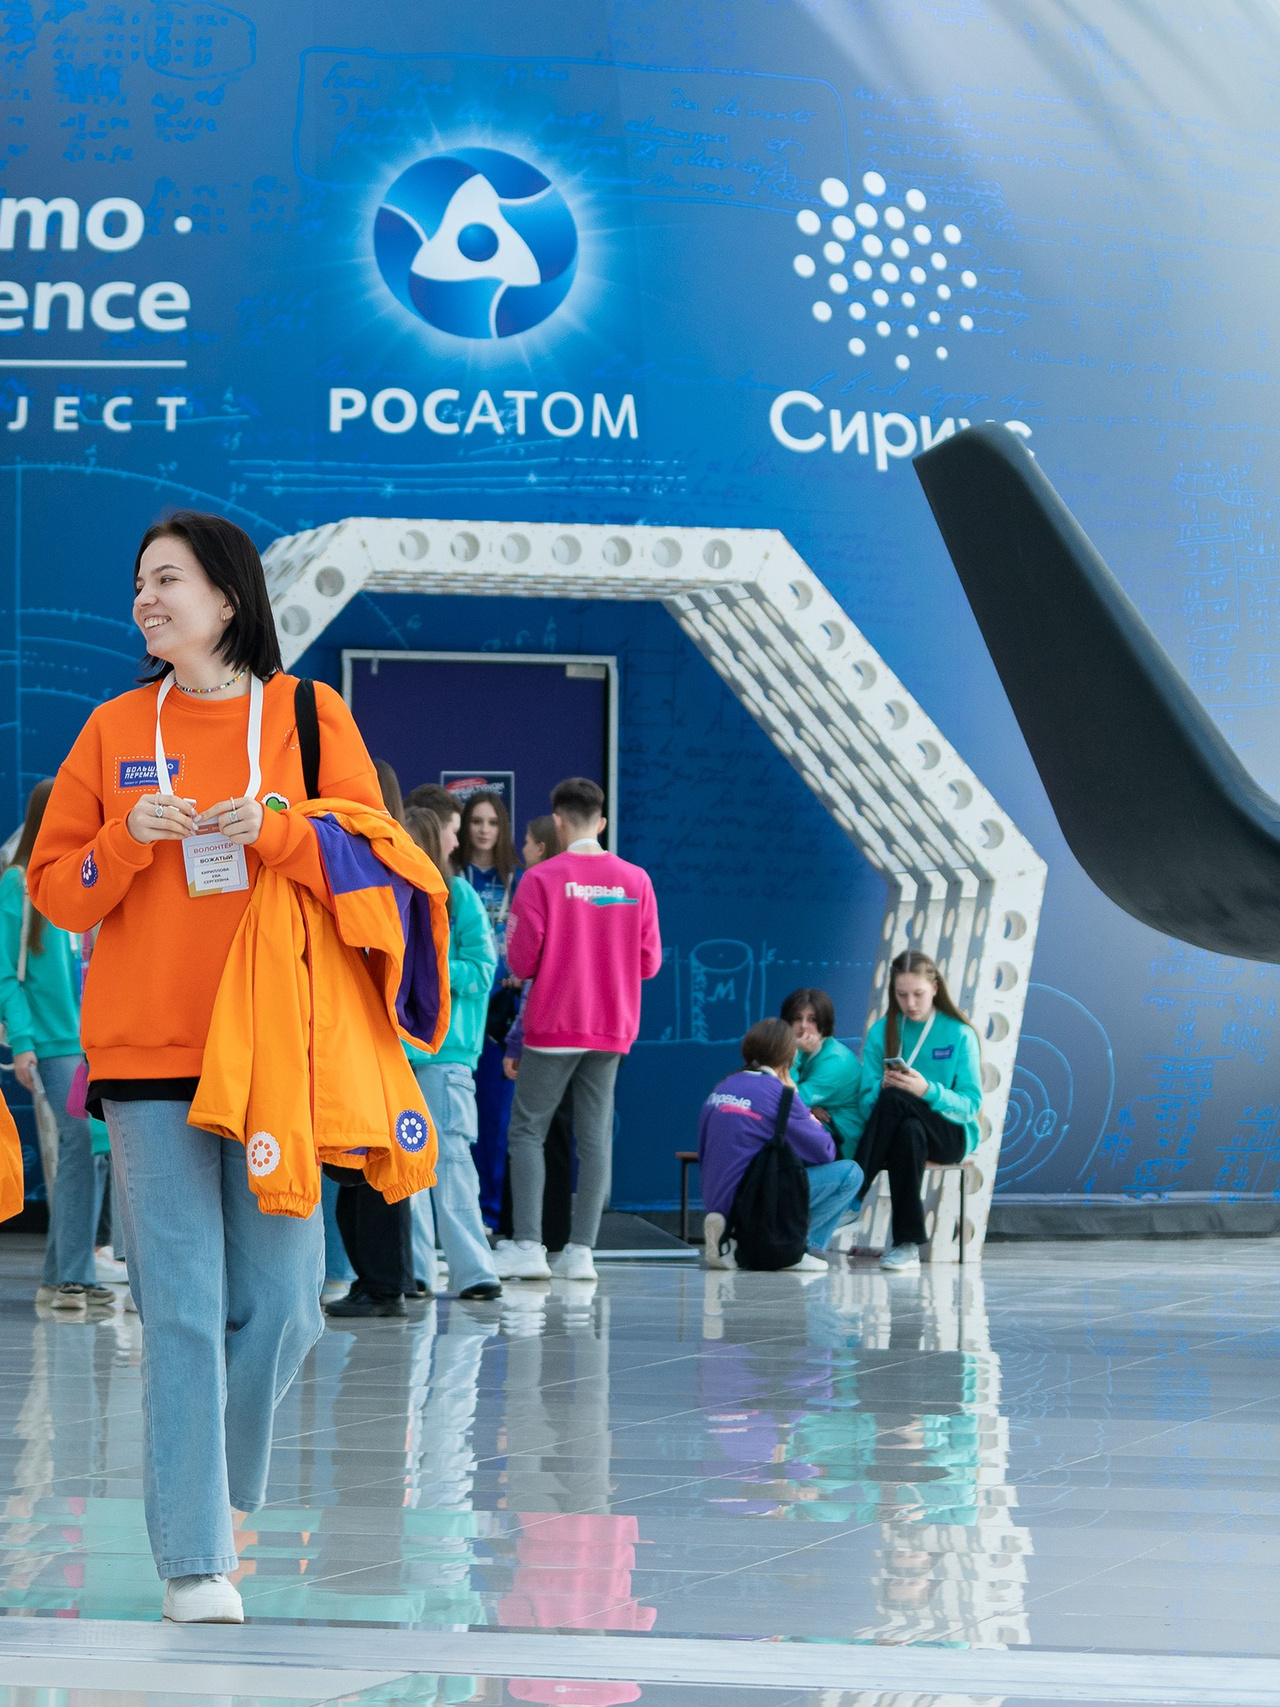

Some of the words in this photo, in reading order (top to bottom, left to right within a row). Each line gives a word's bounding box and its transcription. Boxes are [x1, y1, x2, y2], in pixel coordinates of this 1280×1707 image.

[329, 387, 639, 439] РОСАТОМ
[769, 389, 1035, 473] Сири
[200, 854, 233, 864] ВОЖАТЫЙ
[564, 881, 626, 902] Первые
